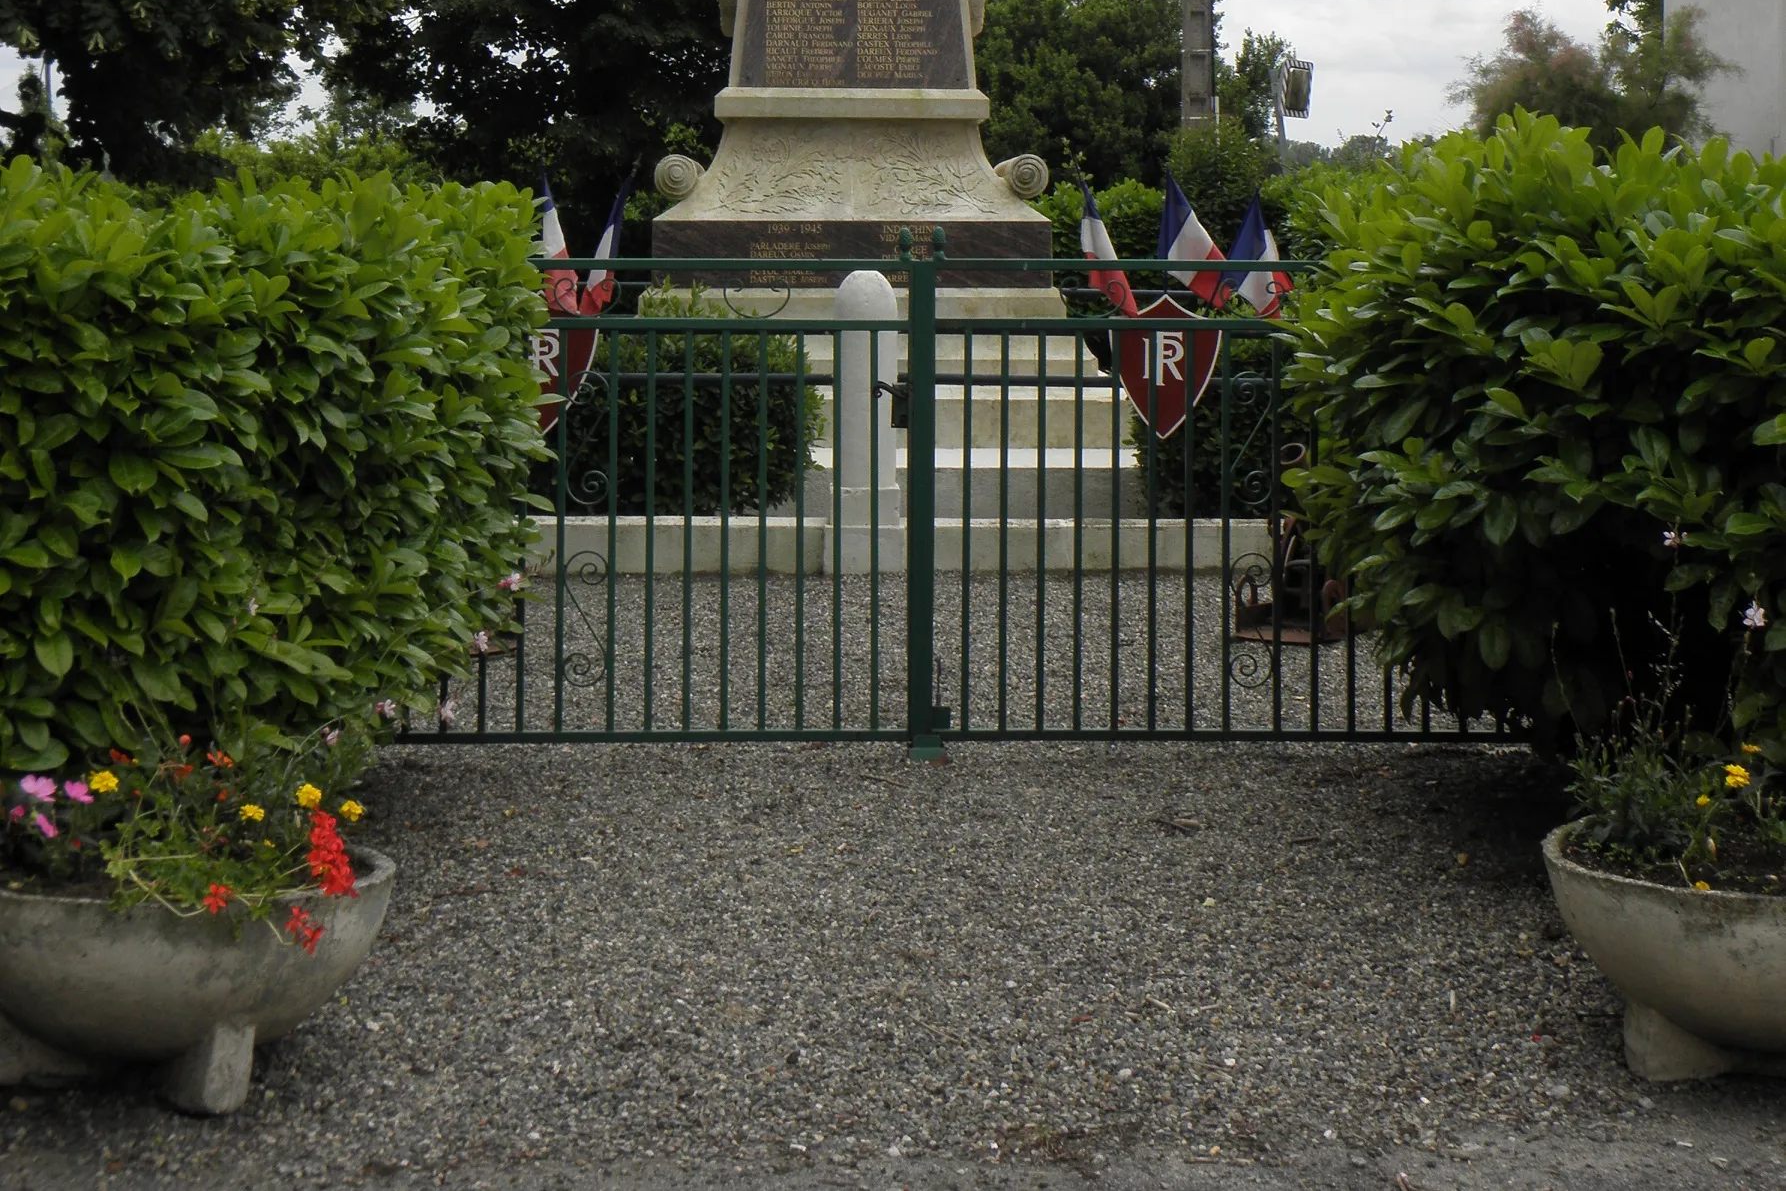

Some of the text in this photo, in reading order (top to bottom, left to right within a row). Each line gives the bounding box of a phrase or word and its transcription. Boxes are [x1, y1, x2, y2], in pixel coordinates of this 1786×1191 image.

[767, 223, 790, 234] 1939
[800, 223, 822, 234] 1945
[894, 245, 928, 254] CREE
